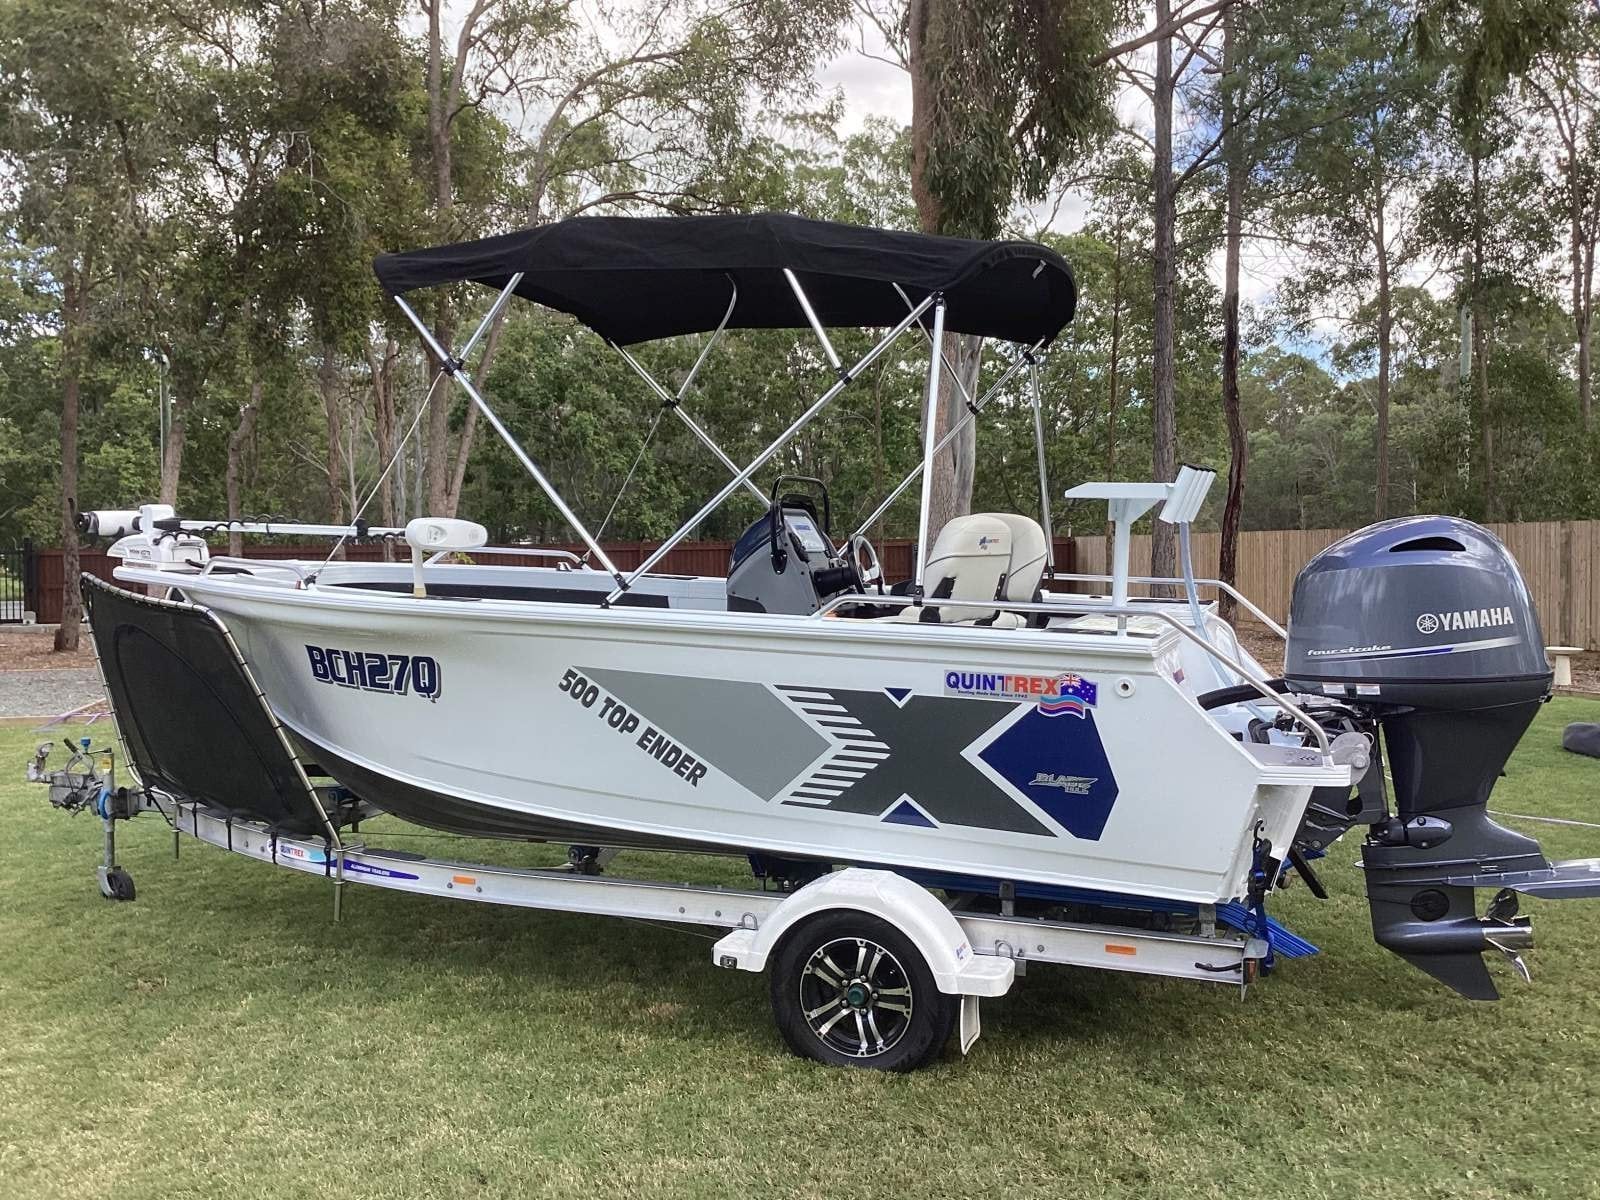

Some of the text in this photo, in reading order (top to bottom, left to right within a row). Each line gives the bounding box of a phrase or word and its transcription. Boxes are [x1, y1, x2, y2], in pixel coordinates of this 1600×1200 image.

[1439, 606, 1514, 632] YAMAHA
[304, 644, 442, 703] BCH27Q
[945, 671, 1059, 696] QUINTREX
[558, 668, 708, 788] 500 TOP ENDER
